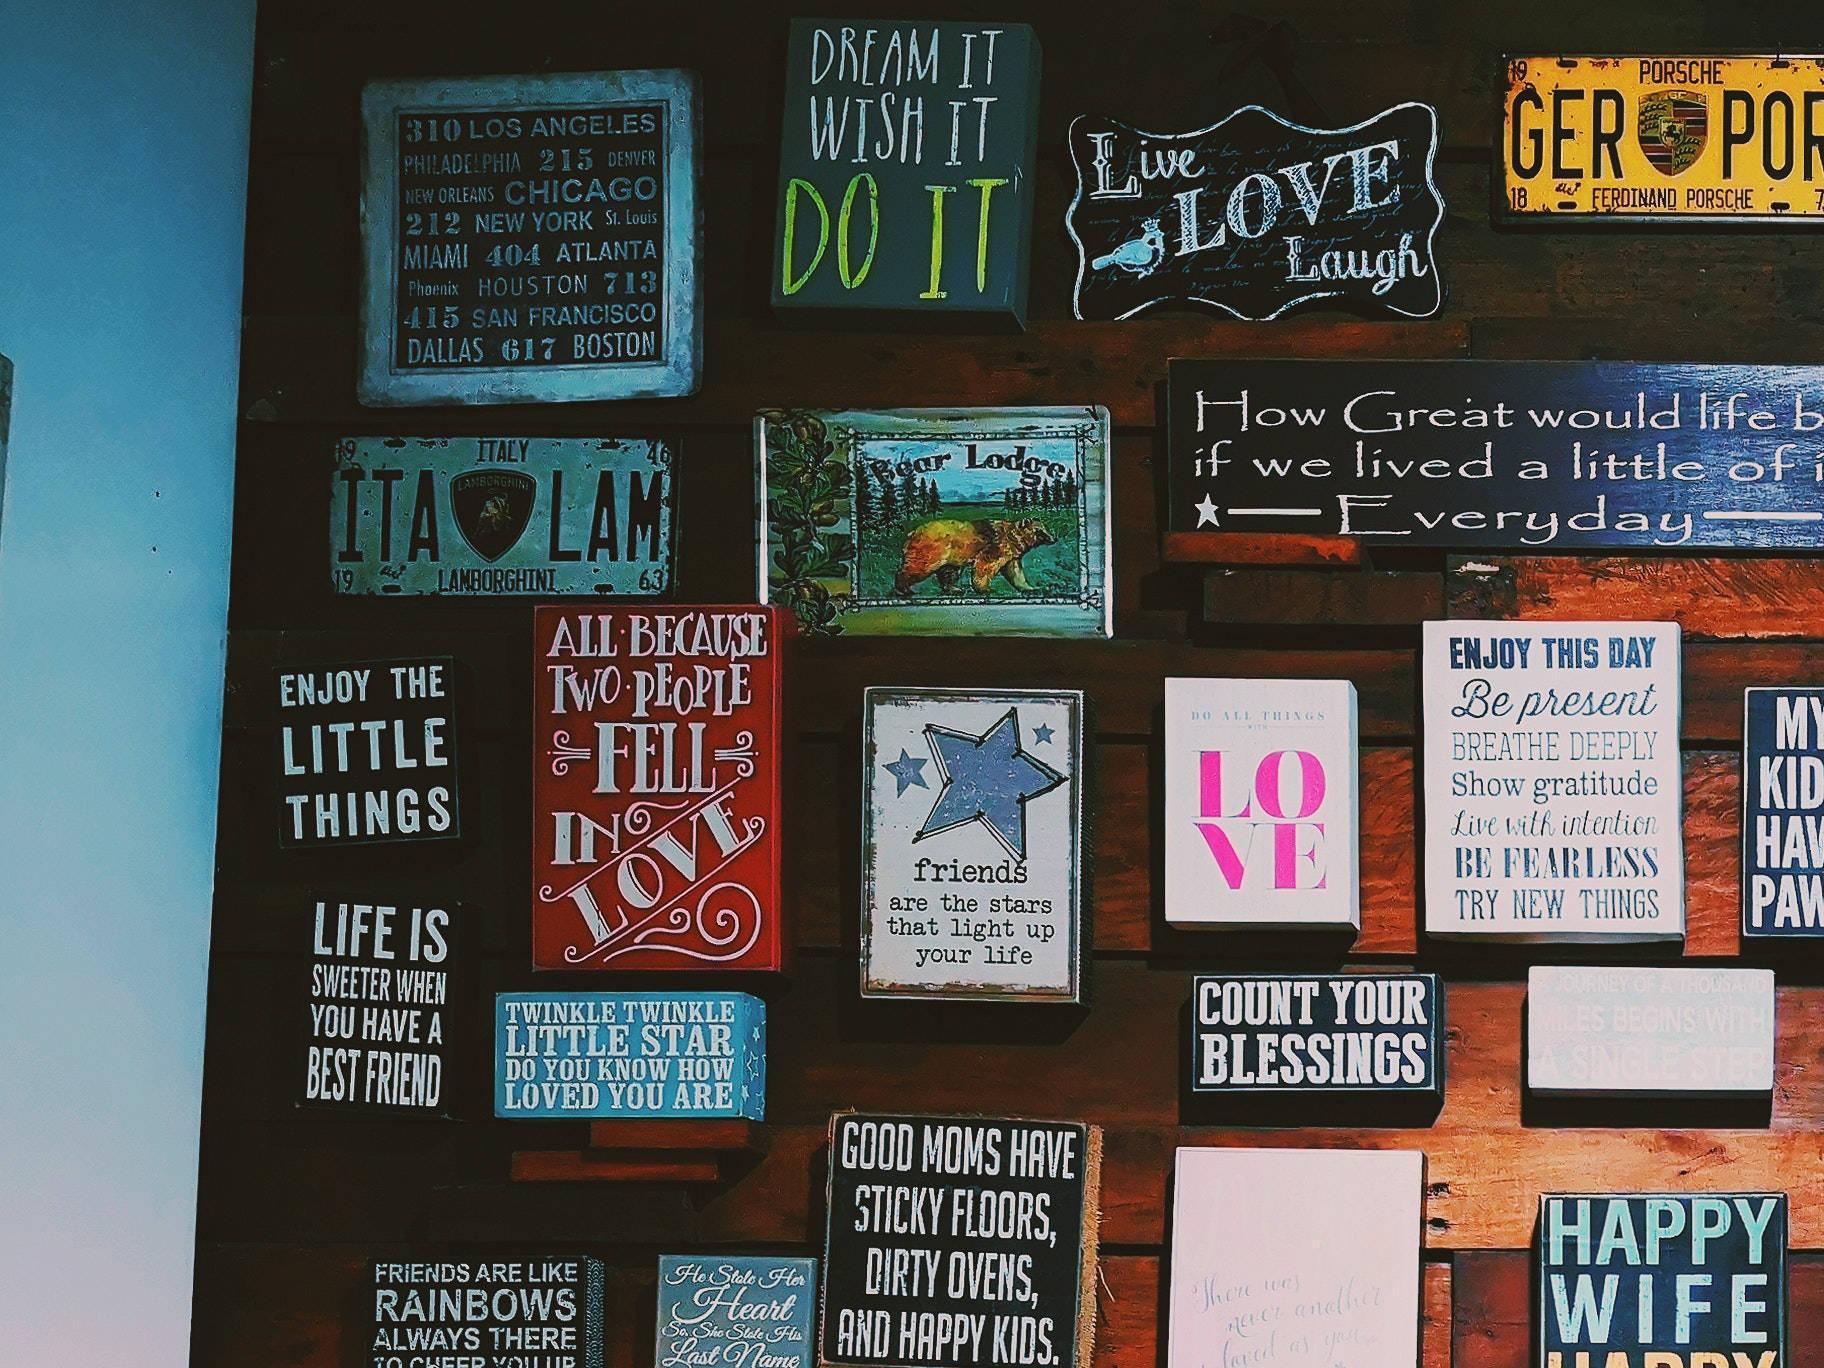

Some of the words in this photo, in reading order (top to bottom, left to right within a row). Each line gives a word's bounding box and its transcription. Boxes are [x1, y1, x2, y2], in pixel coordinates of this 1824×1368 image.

[812, 29, 938, 85] DREAM
[959, 30, 1004, 88] IT
[1639, 60, 1724, 84] PORSCHE
[405, 118, 461, 141] 310
[470, 118, 521, 139] LOS
[531, 114, 655, 136] ANGELES
[811, 94, 924, 164] WISH
[946, 96, 997, 166] IT
[1511, 90, 1624, 181] GER
[1090, 132, 1205, 198] Live
[1174, 141, 1399, 256] LOVE
[1592, 187, 1677, 210] FERDINAND
[1685, 187, 1753, 210] PORSCHE
[404, 242, 469, 269] MIAMI
[485, 241, 541, 268] 404
[557, 240, 657, 262] ATLANTA
[784, 175, 879, 294] DO
[920, 178, 1009, 298] IT
[1286, 233, 1428, 294] Laugh
[408, 338, 483, 364] DALLAS
[501, 338, 558, 361] 617
[573, 333, 655, 358] BOSTON
[1195, 391, 1328, 432] How
[1343, 391, 1514, 432] Great
[1527, 395, 1681, 430] would
[1700, 394, 1775, 430] life
[477, 440, 529, 462] ITALY
[871, 452, 951, 482] Bear
[965, 445, 1065, 488] Lodge
[339, 470, 439, 561] ITA
[550, 469, 662, 561] LAM
[1339, 494, 1695, 544] Everyday
[438, 569, 556, 592] LAMBORGHINI
[1450, 637, 1530, 669] ENJOY
[1542, 638, 1598, 668] THIS
[1609, 637, 1656, 668] DAY
[280, 670, 370, 707] ENJOY
[391, 665, 444, 698] THE
[282, 718, 447, 775] LITTLE
[1452, 772, 1524, 796] Show
[1534, 771, 1658, 802] gratitude
[286, 787, 451, 839] THINGS
[913, 858, 1028, 884] friends
[889, 896, 928, 913] are
[943, 893, 979, 913] the
[989, 895, 1052, 914] stars
[1455, 890, 1499, 920] TRY
[1513, 890, 1564, 919] NEW
[1581, 889, 1659, 918] THINGS
[915, 948, 972, 967] your
[984, 945, 1033, 964] life
[505, 1002, 616, 1024] TWINKLE
[624, 1001, 735, 1023] TWINKLE
[1200, 982, 1319, 1024] COUNT
[1328, 980, 1427, 1024] YOUR
[1200, 1033, 1426, 1084] BLESSINGS
[842, 1121, 913, 1171] GOOD
[922, 1126, 1001, 1176] MOMS
[1009, 1131, 1076, 1178] HAVE
[1548, 1199, 1776, 1265] HAPPY
[376, 1263, 470, 1283] FRIENDS
[475, 1264, 521, 1282] ARE
[529, 1263, 577, 1282] LIKE
[376, 1289, 577, 1322] RAINBOWS
[1548, 1274, 1767, 1343] WIFE
